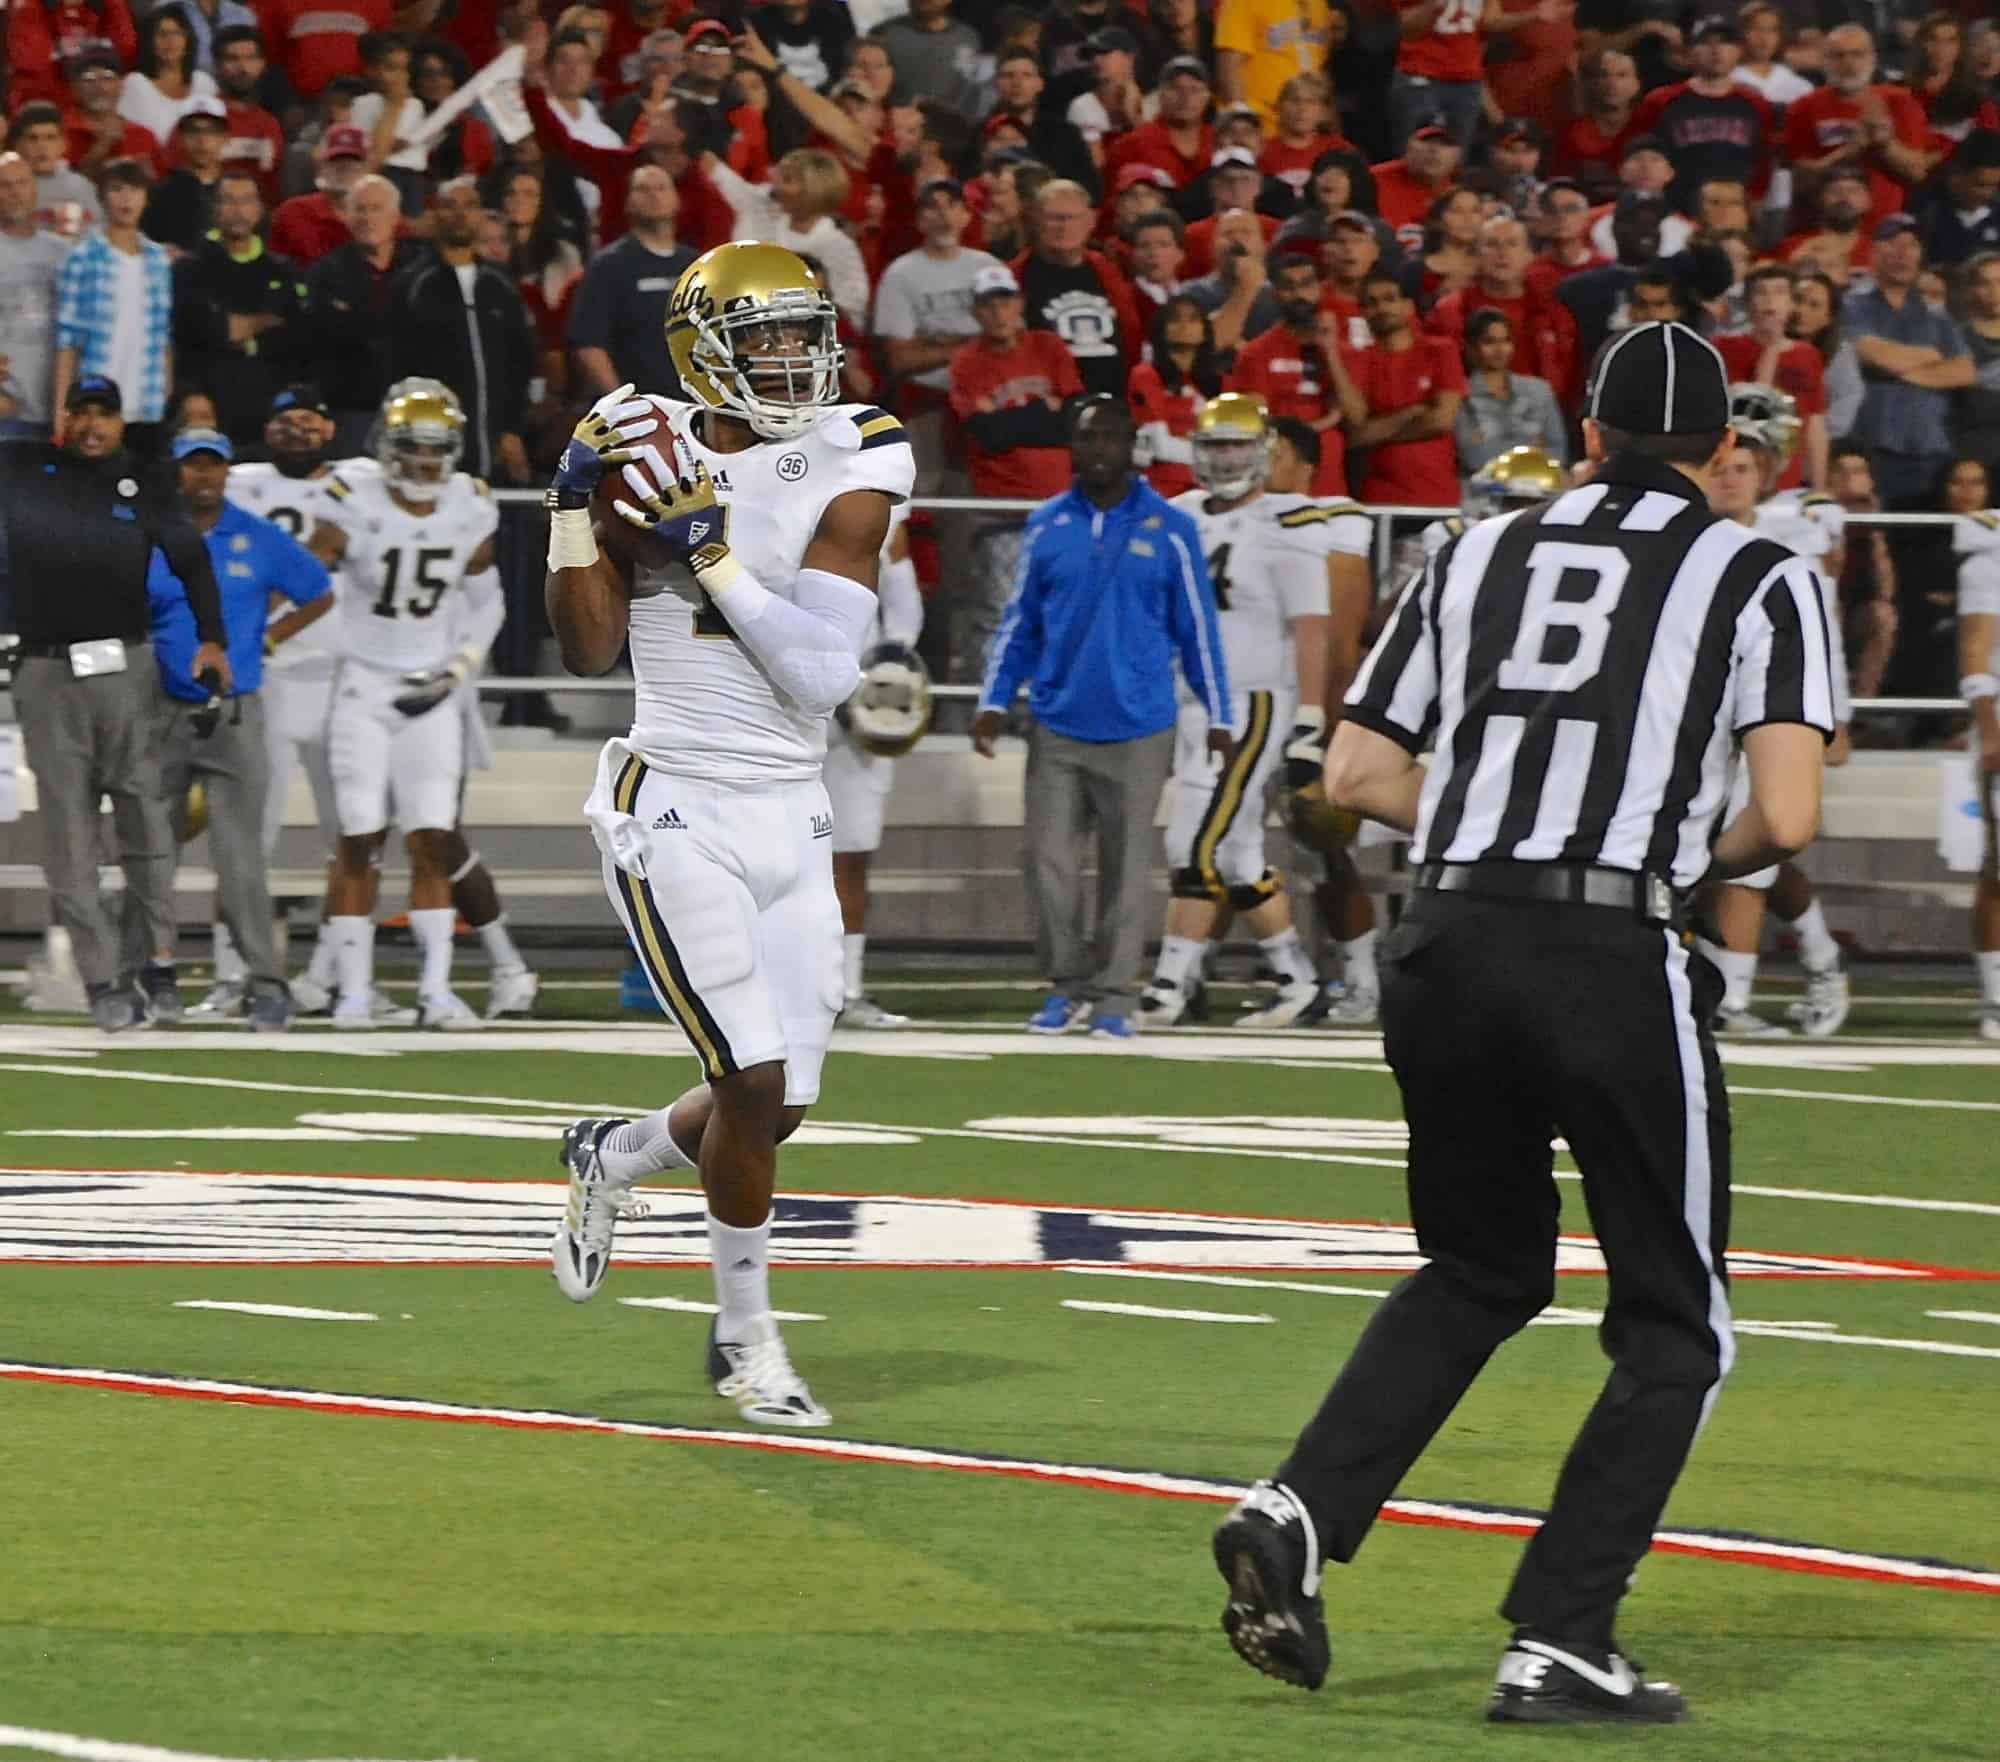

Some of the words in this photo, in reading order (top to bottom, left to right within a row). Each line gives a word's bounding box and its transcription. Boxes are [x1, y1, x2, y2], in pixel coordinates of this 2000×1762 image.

[671, 270, 715, 321] cla
[781, 457, 802, 475] 36
[371, 547, 453, 619] 15
[1497, 541, 1632, 692] B
